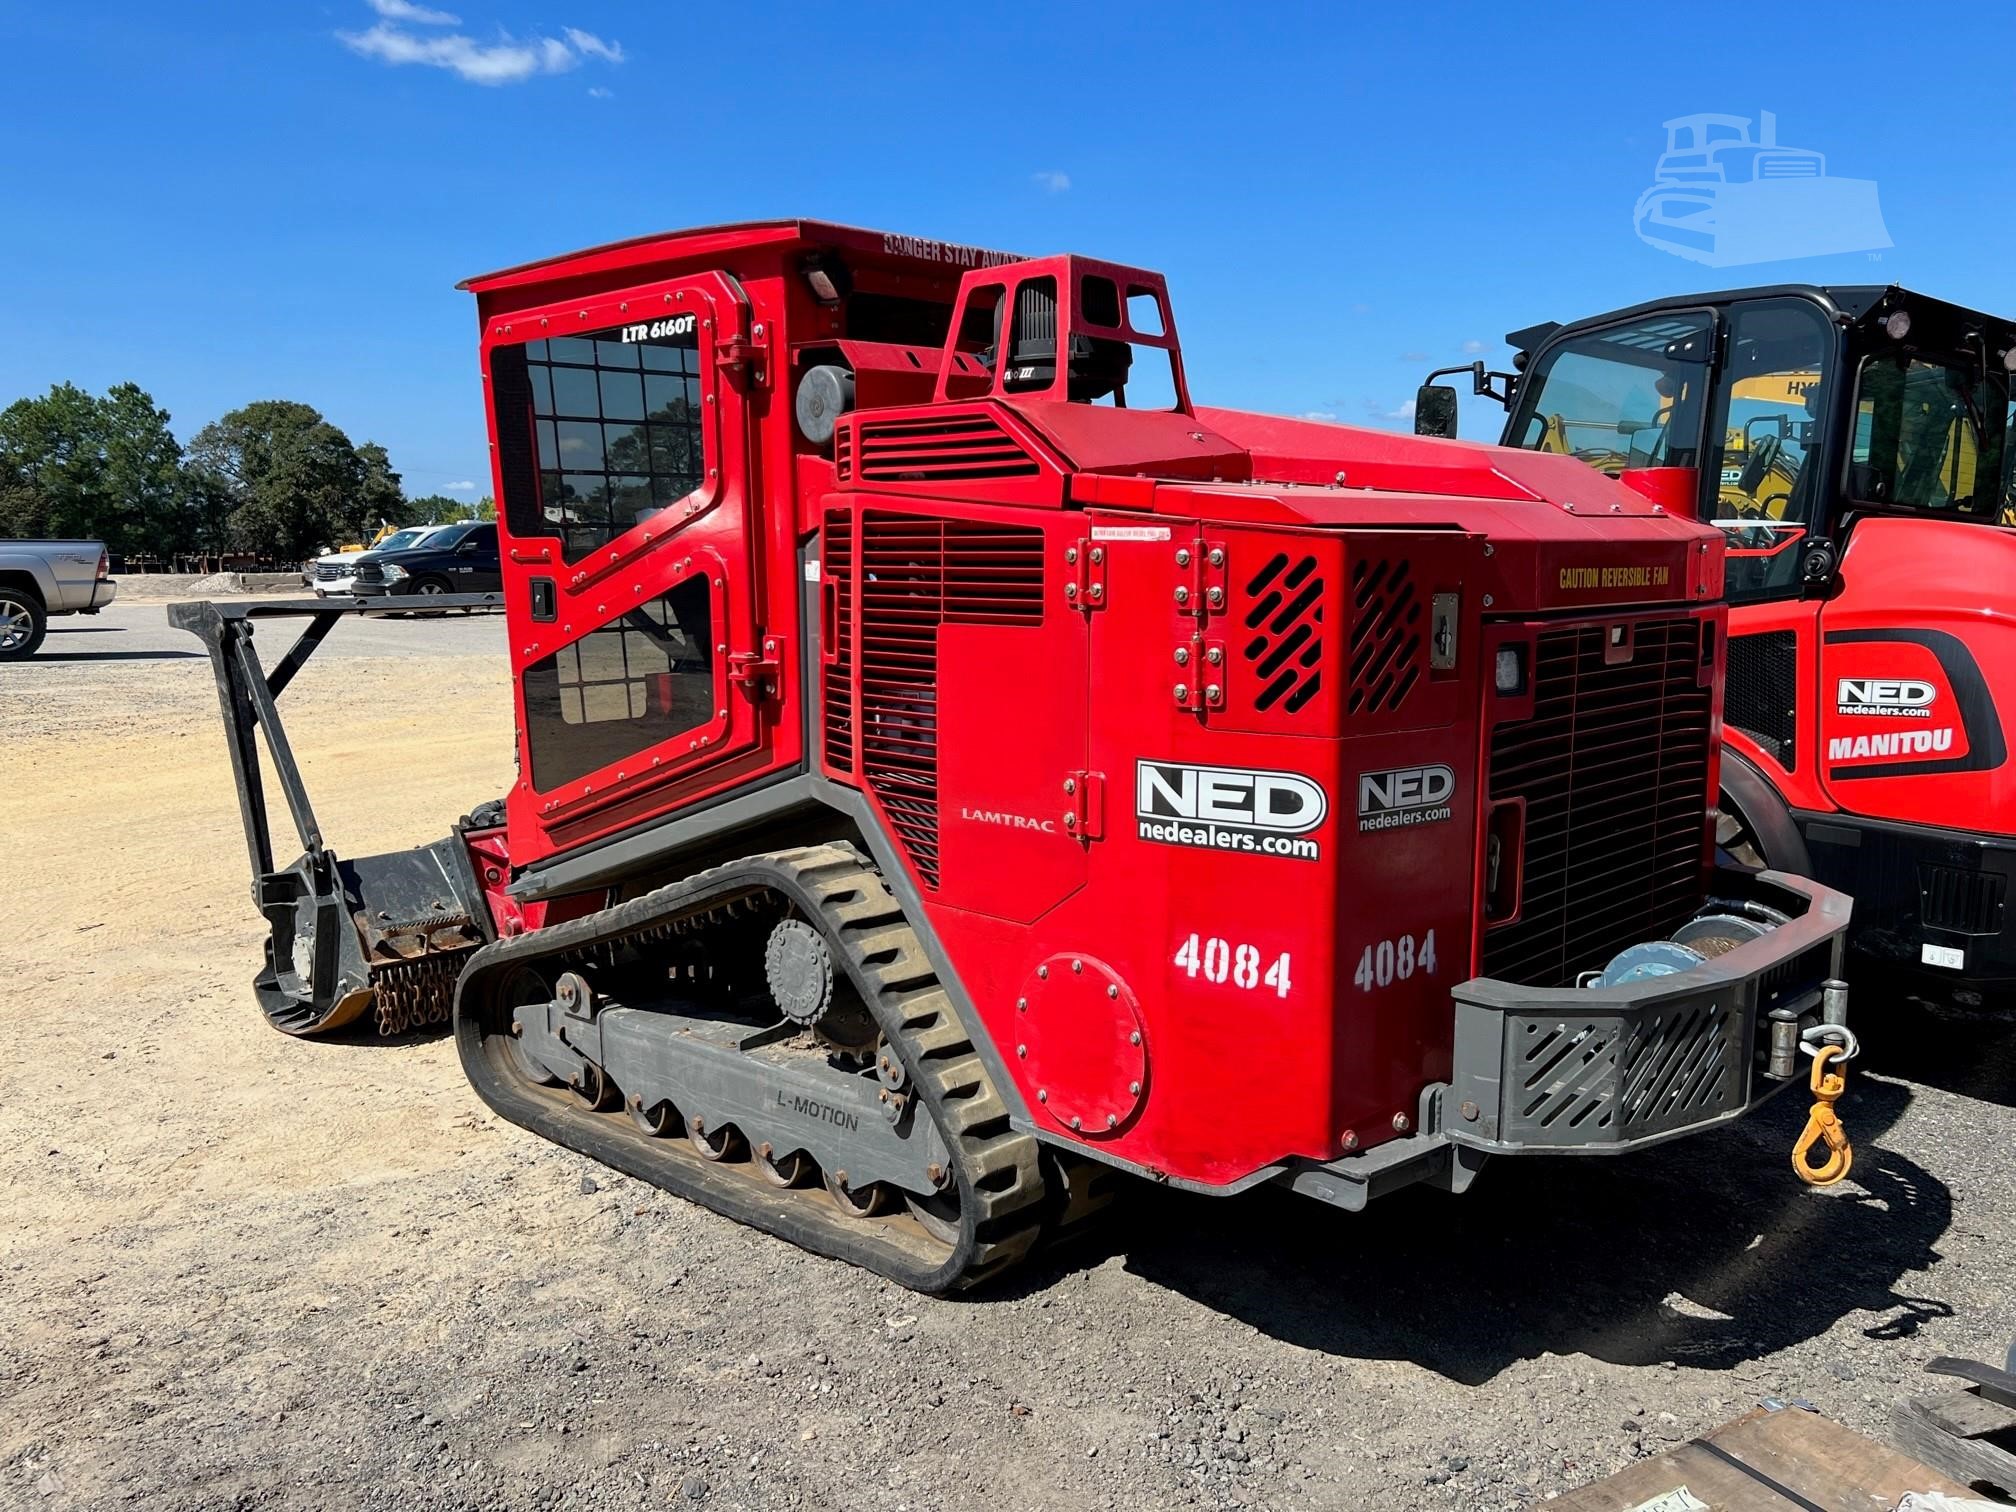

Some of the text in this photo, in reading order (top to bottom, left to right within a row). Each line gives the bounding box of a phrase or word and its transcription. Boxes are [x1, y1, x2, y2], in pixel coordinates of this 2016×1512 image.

[883, 233, 941, 262] DANGER
[945, 243, 977, 267] STAY
[622, 315, 696, 343] LTR 6160T
[1721, 470, 1742, 480] ED
[1560, 566, 1669, 589] CAUTION REVERSIBLE FAN
[1840, 680, 1935, 706] NED
[1839, 704, 1931, 717] nedealers.com
[1828, 728, 1953, 760] MANITOU
[1139, 763, 1325, 831] NED
[1360, 766, 1454, 813] NED
[962, 808, 1056, 833] LAMTRAC
[1359, 807, 1451, 832] nedealers.com
[1139, 821, 1319, 860] nedealers.com
[1174, 933, 1292, 999] 4084
[1354, 928, 1437, 993] 4084
[777, 1090, 859, 1132] L-MOTION
